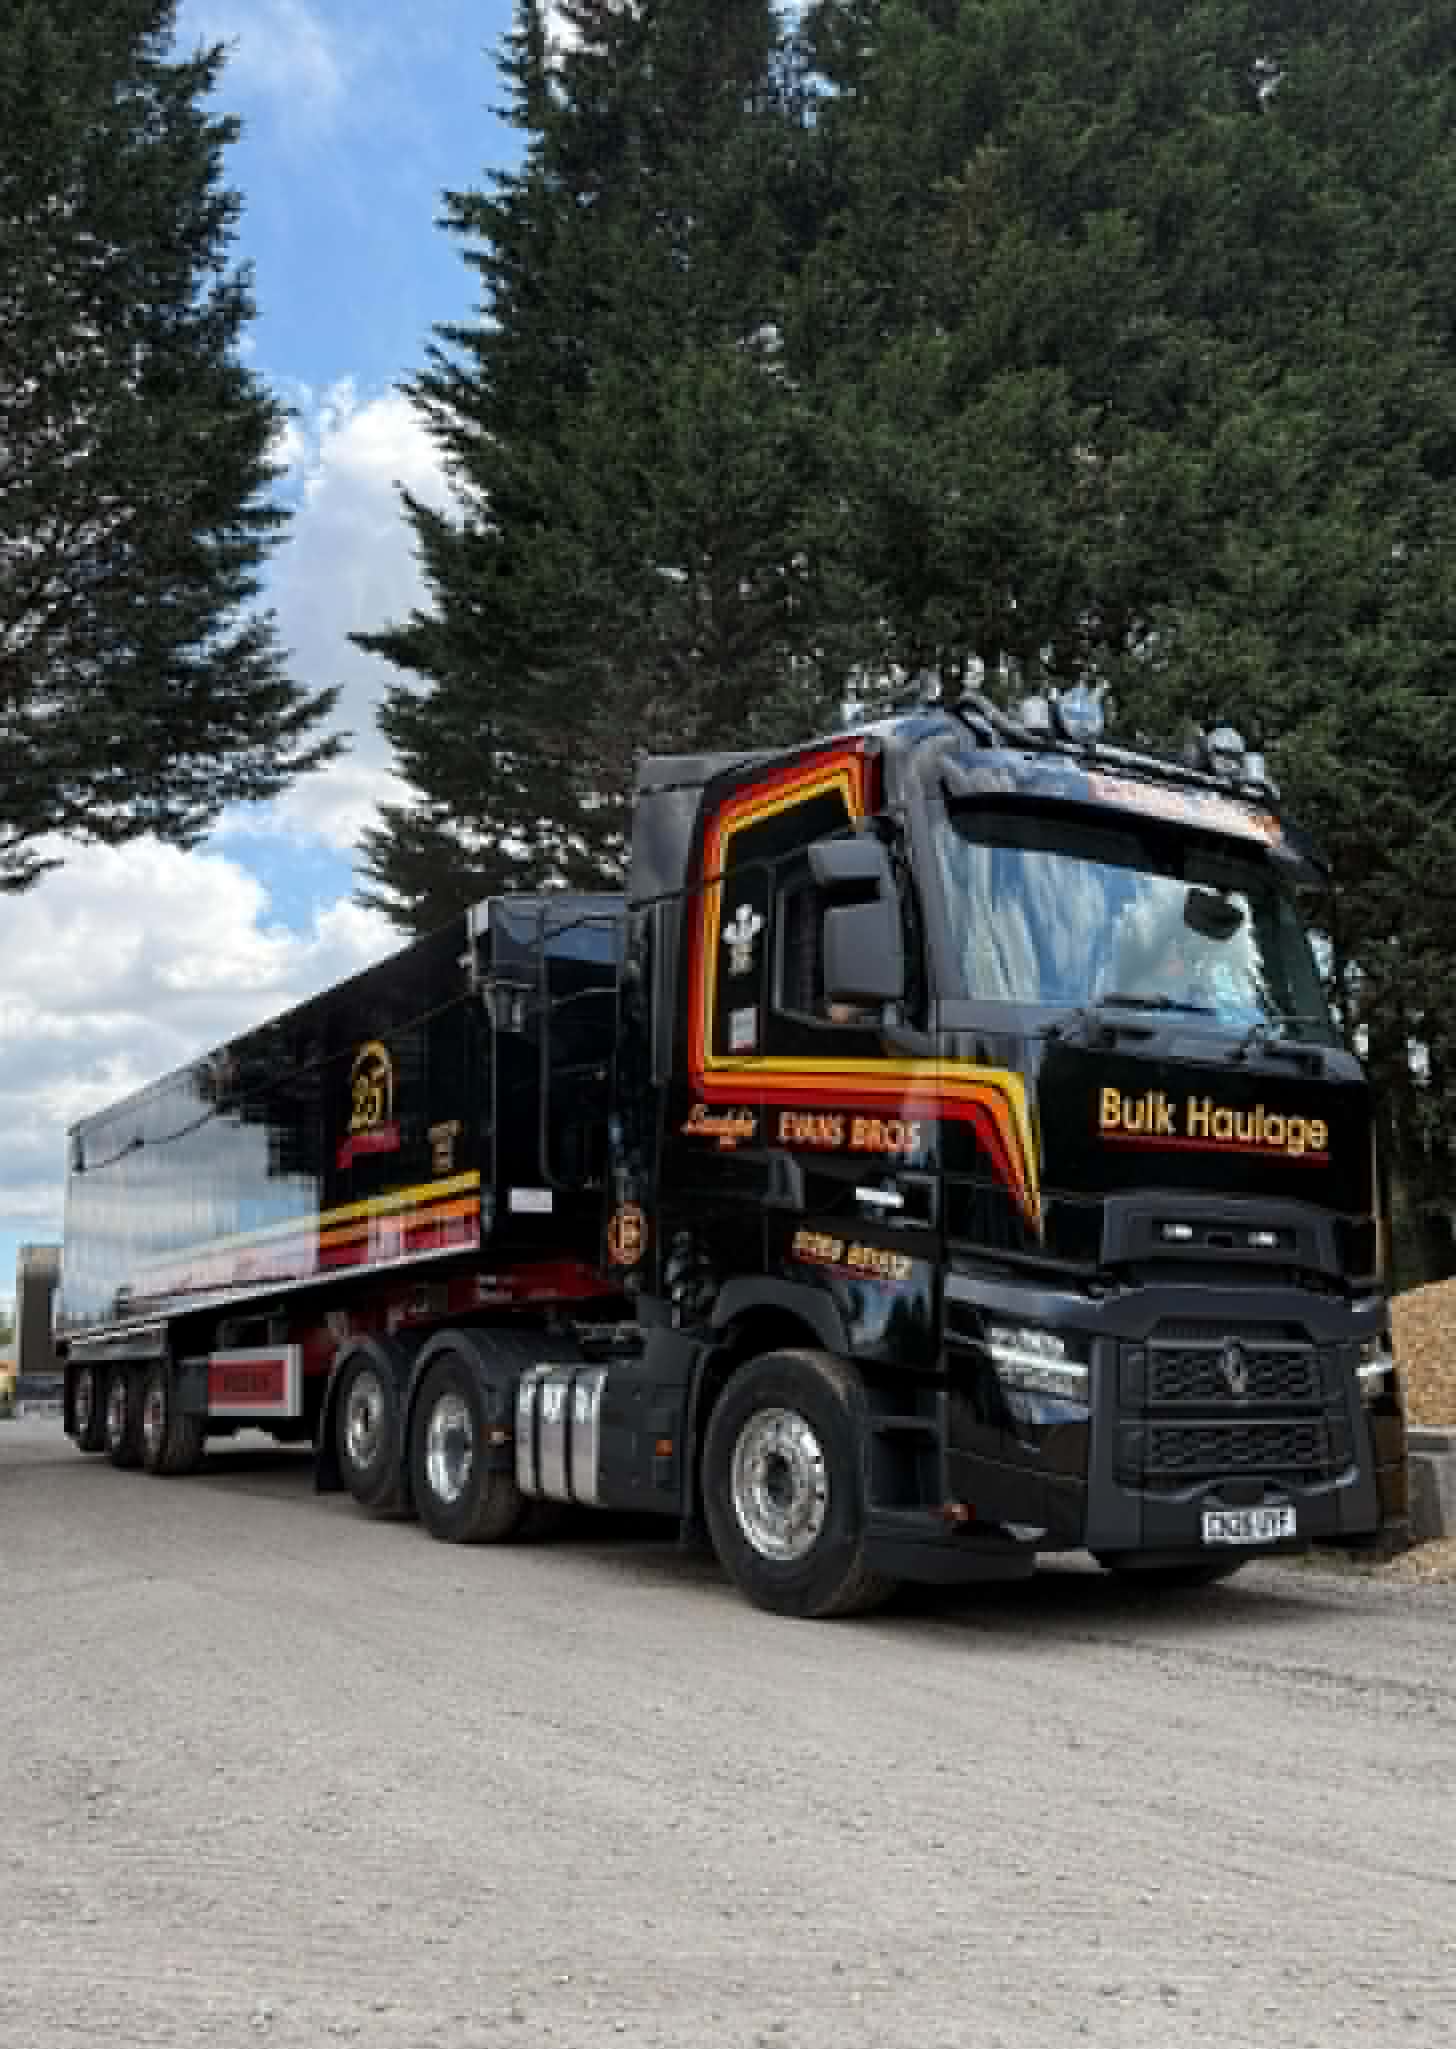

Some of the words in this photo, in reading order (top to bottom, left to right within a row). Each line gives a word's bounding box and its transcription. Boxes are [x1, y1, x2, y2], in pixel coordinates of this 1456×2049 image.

[849, 1118, 923, 1153] BROS
[1099, 1087, 1176, 1136] Bulk
[1186, 1096, 1328, 1158] Haulage
